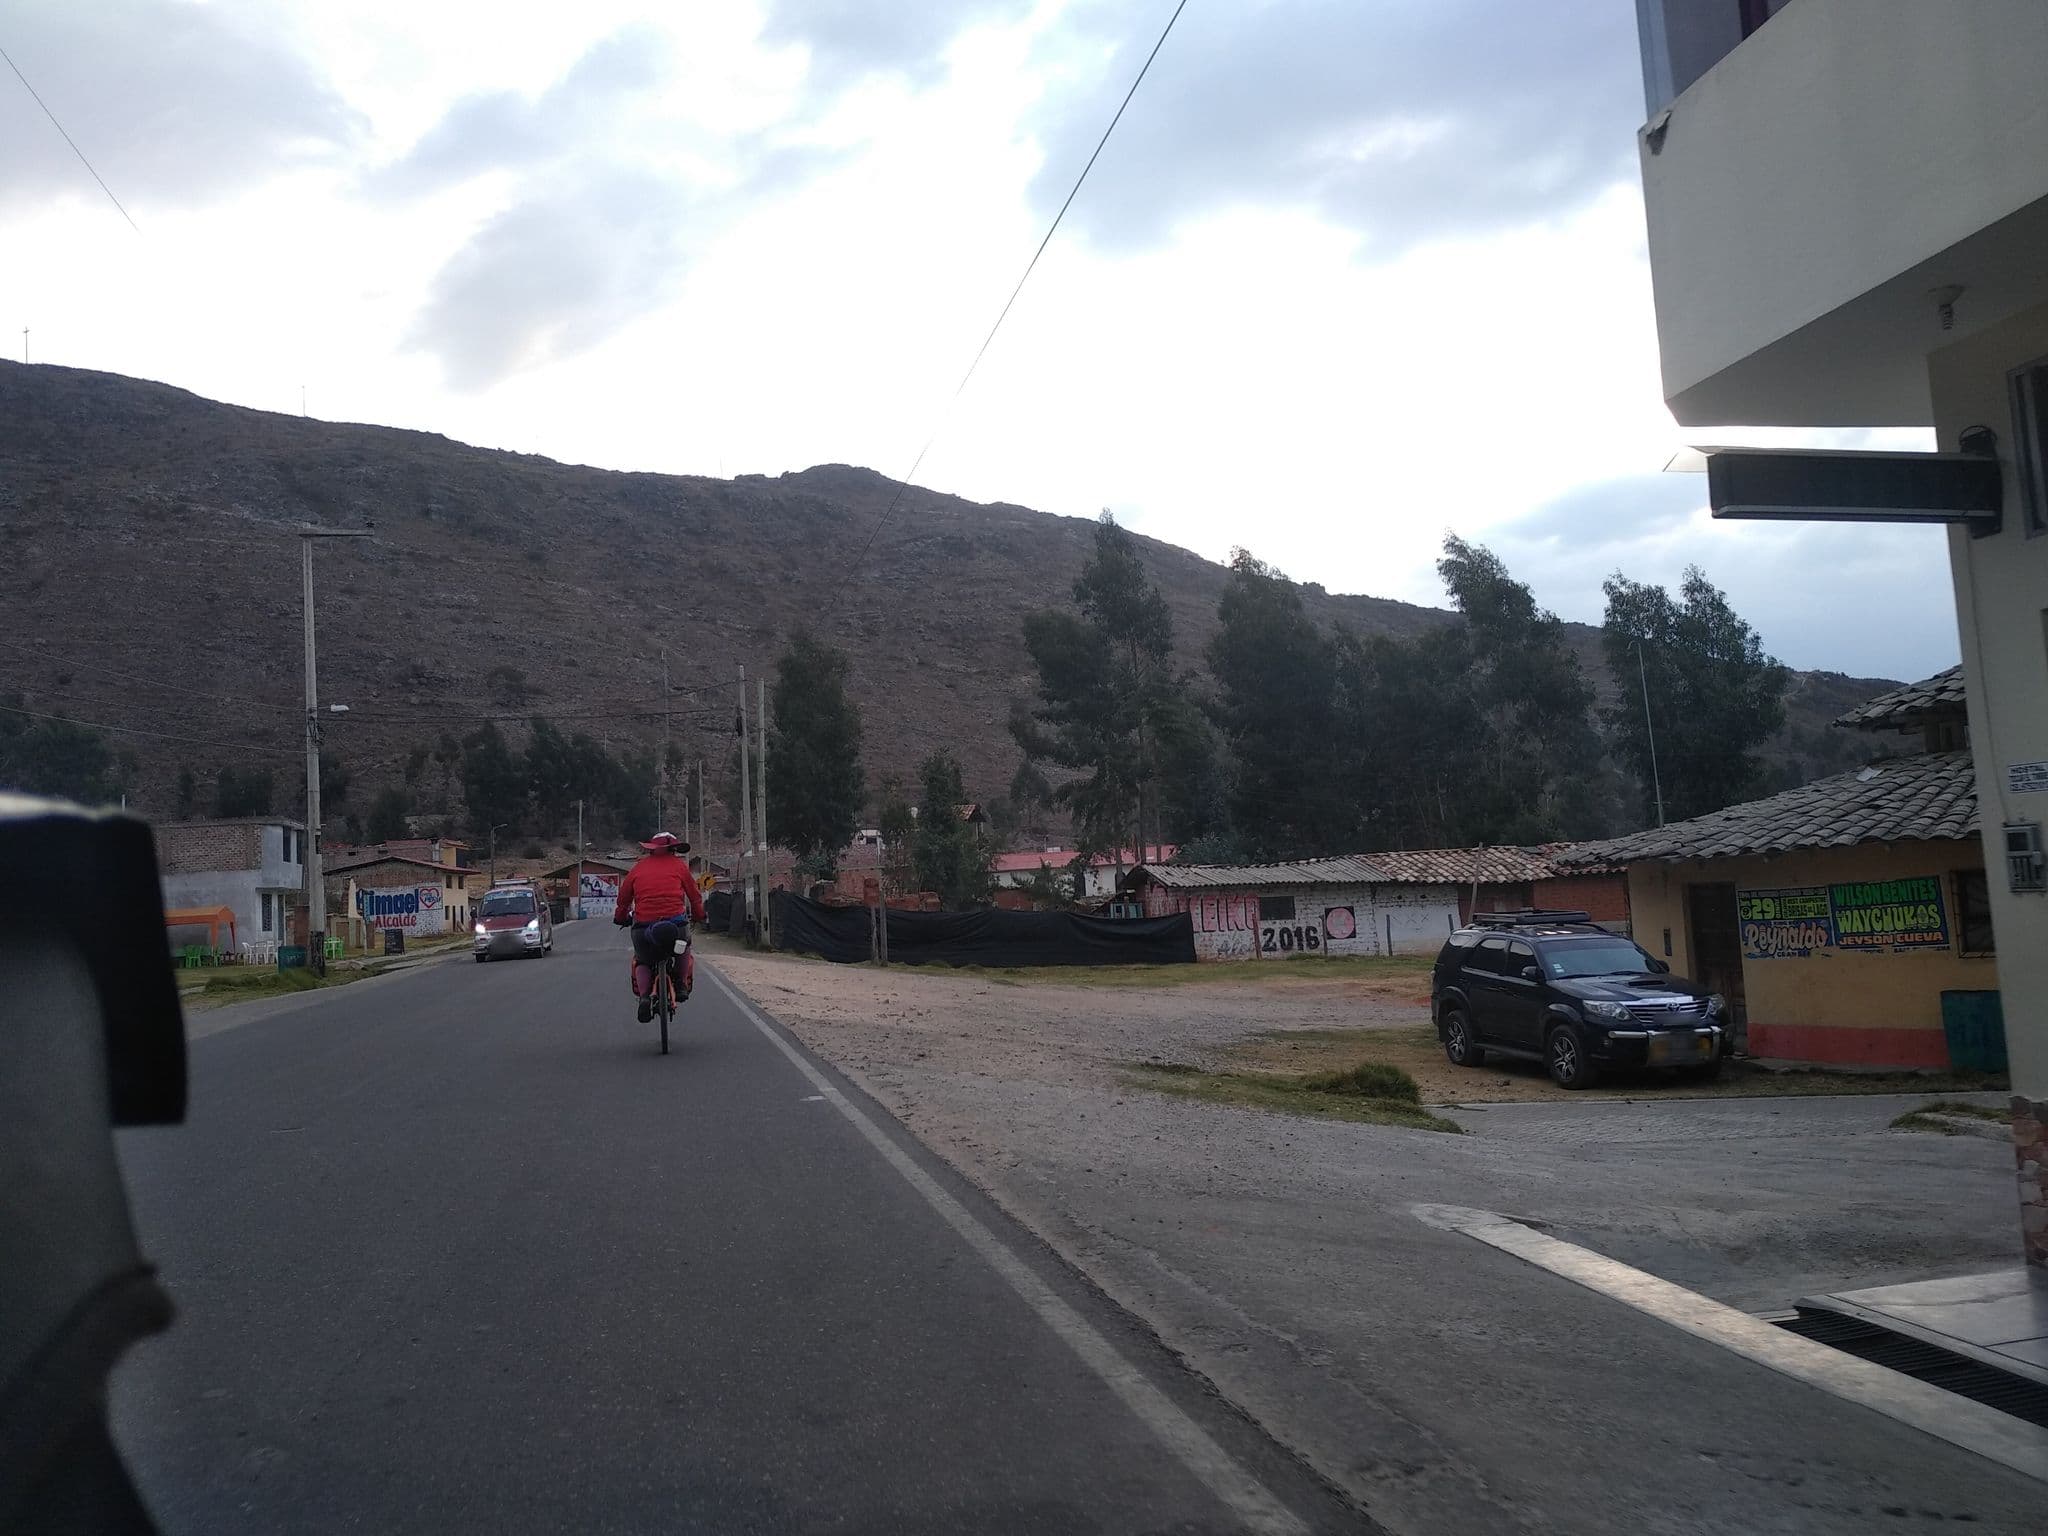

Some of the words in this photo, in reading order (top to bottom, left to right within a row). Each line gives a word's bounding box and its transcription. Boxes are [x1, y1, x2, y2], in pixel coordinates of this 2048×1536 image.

[1751, 897, 1775, 920] 29
[375, 915, 417, 928] Alcalde
[1262, 926, 1321, 952] 2016
[1745, 921, 1828, 954] Reynaldo
